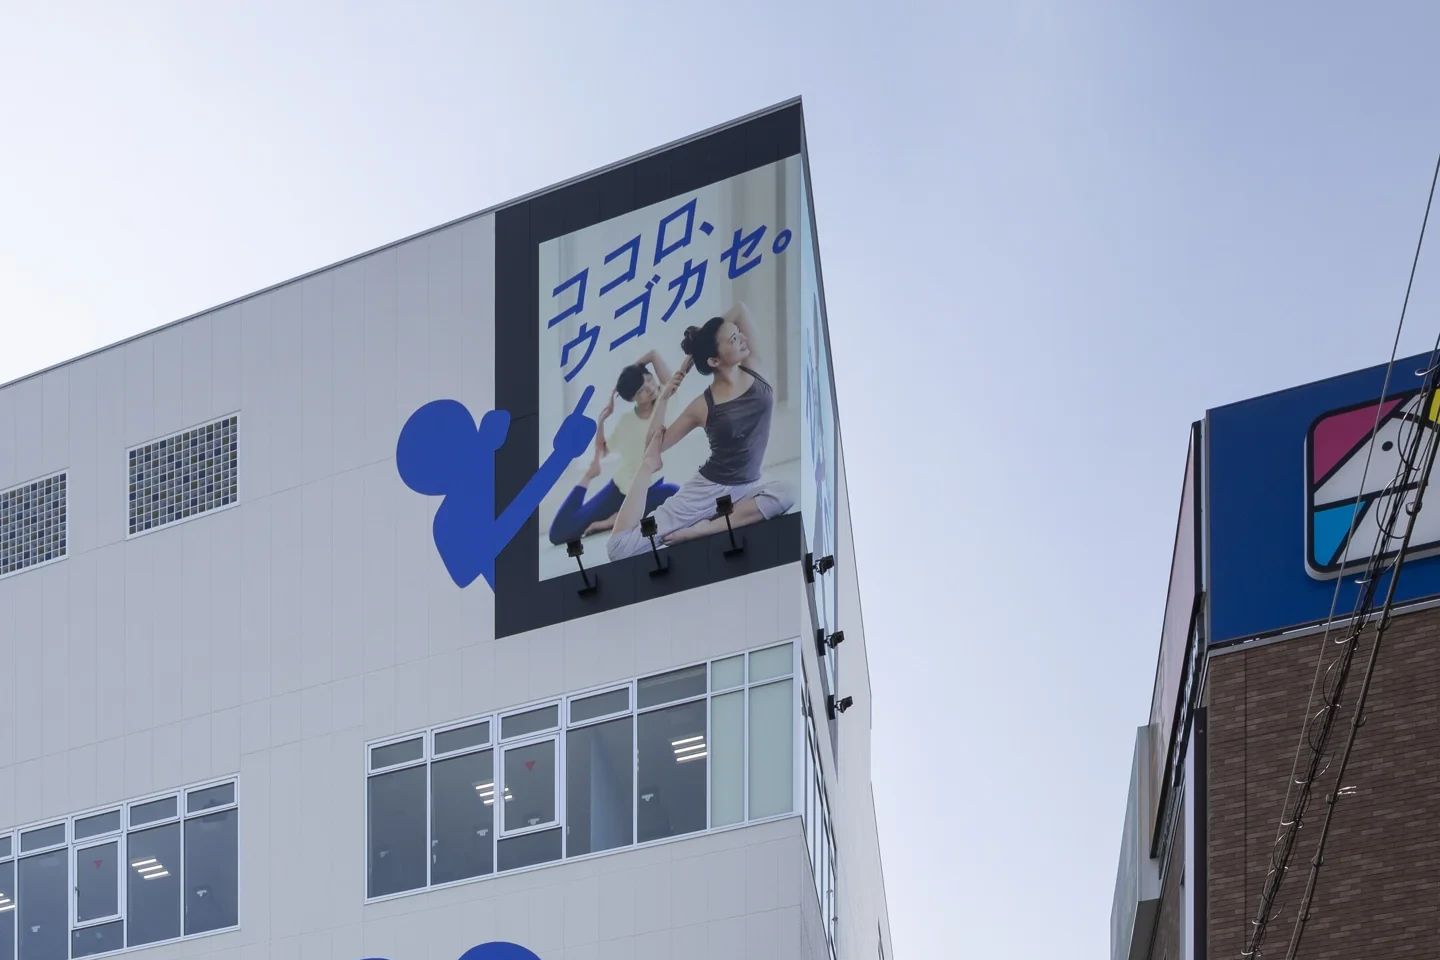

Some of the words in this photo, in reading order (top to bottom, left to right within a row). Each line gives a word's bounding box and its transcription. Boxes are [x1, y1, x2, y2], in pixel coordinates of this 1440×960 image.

[547, 197, 714, 329] ココロ、
[560, 225, 792, 383] ウゴカセ。
